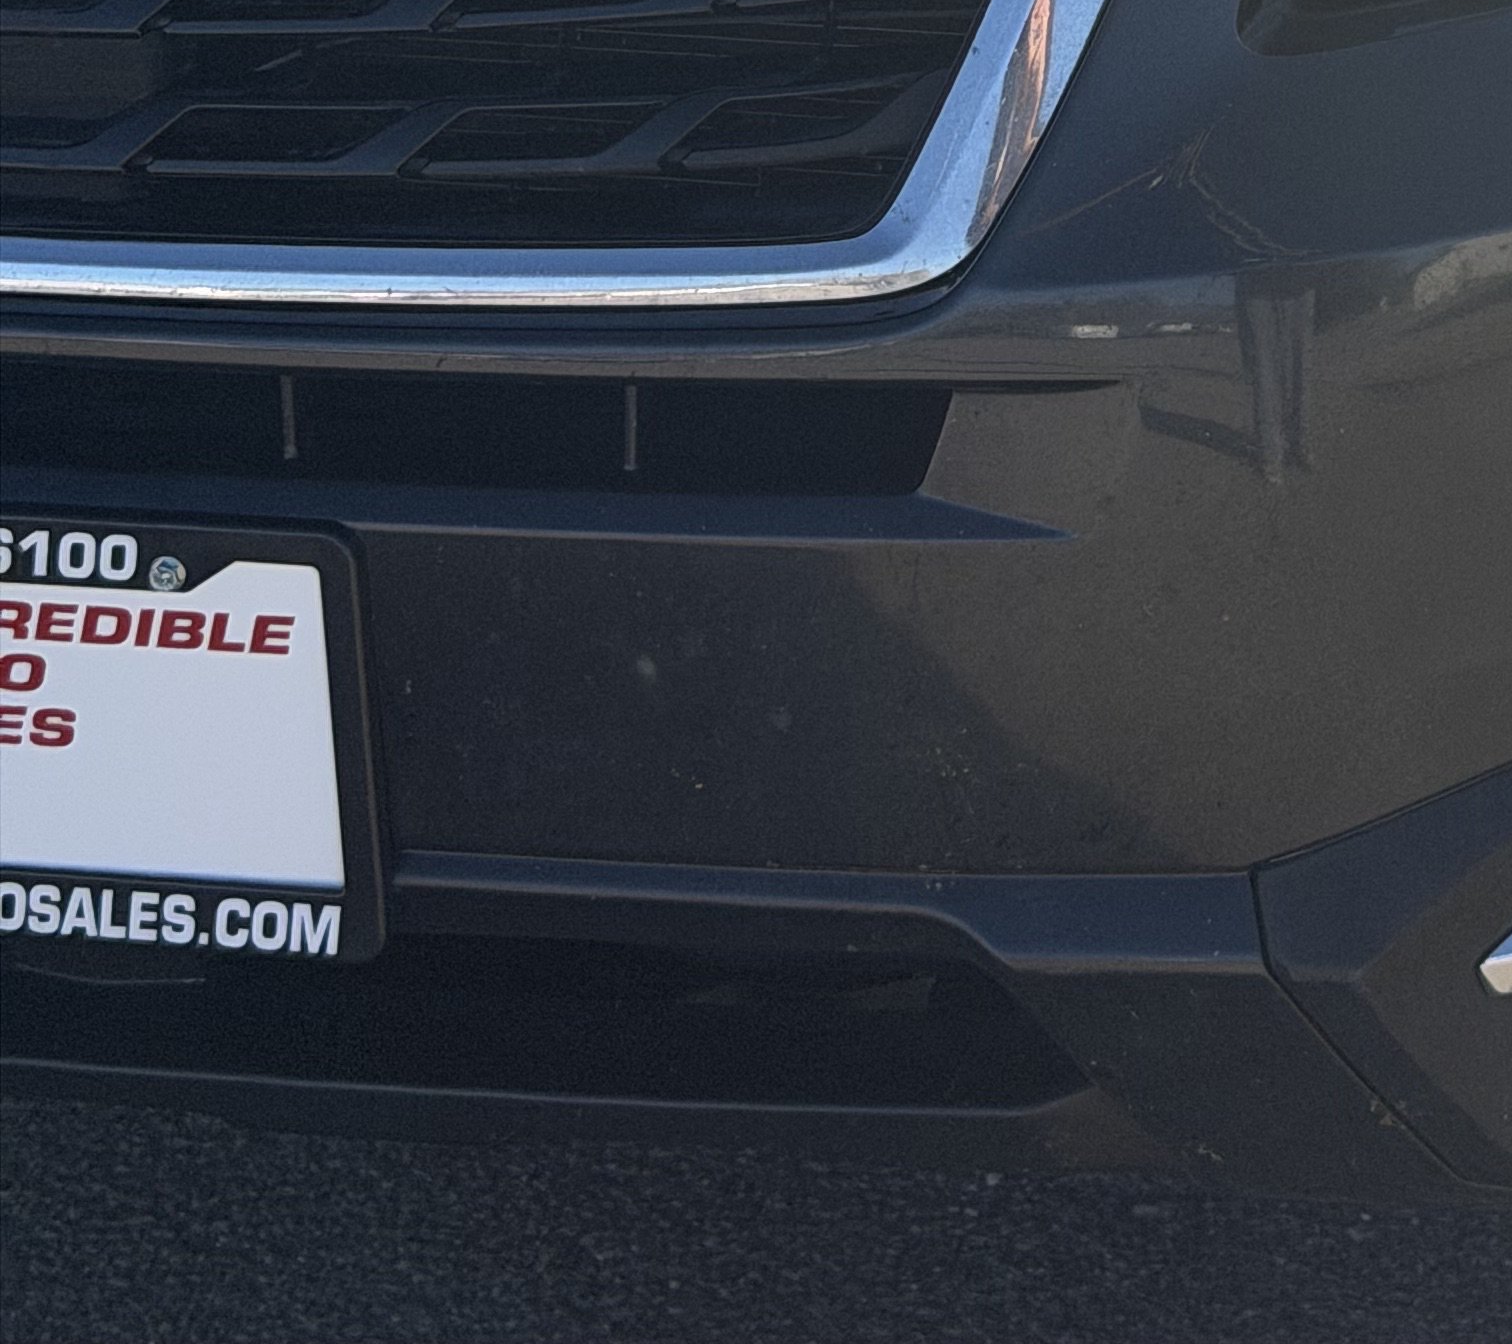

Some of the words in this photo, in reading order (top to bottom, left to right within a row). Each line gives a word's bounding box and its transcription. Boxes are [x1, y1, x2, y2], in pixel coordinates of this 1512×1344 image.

[0, 600, 296, 655] REDIBLE
[0, 653, 47, 692] O
[0, 705, 77, 747] ES
[0, 881, 342, 955] OSALES.COM
